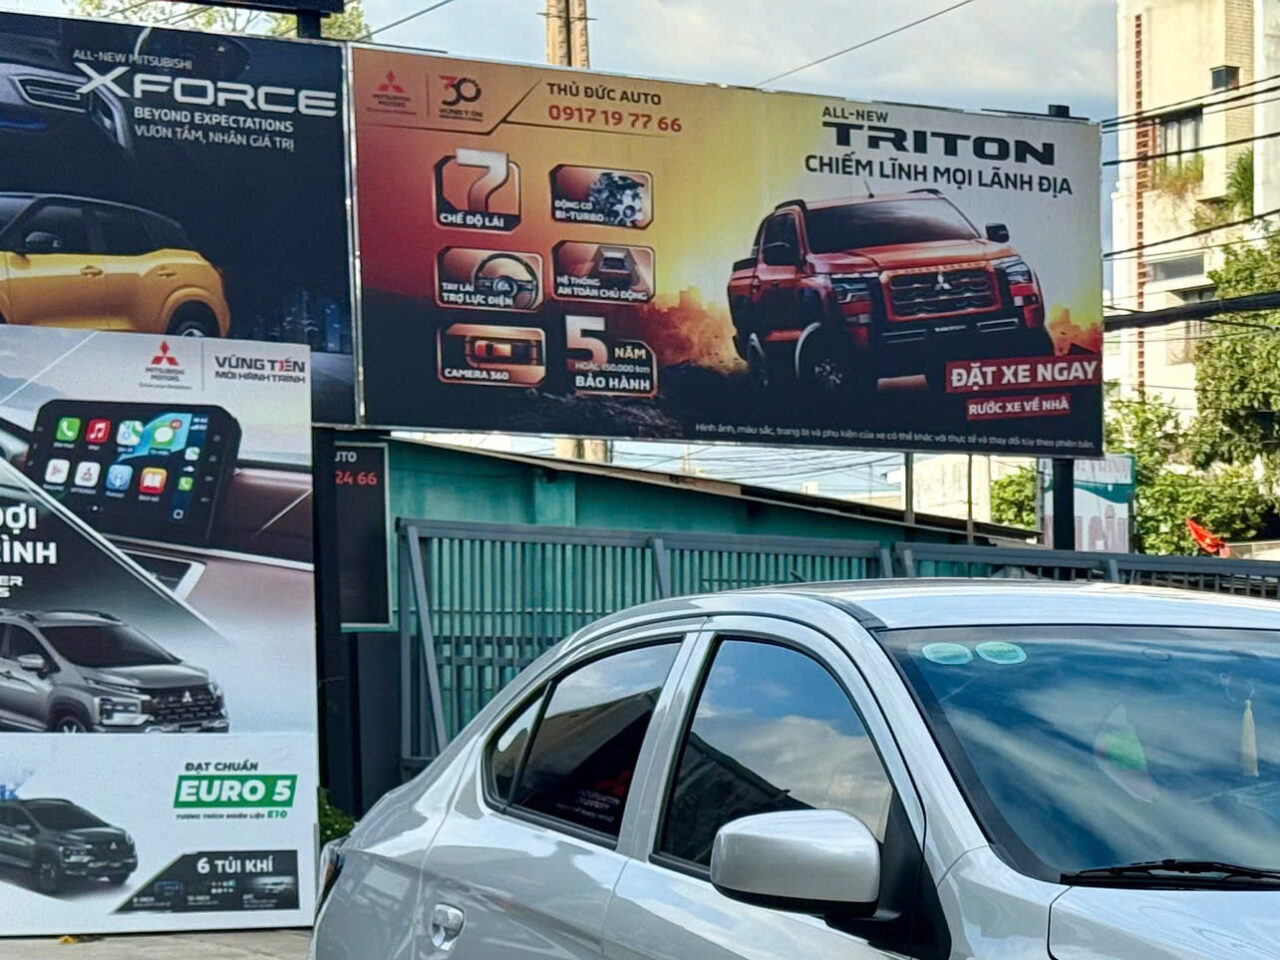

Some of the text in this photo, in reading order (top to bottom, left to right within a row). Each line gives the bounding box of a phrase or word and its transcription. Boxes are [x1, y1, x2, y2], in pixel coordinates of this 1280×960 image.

[72, 49, 193, 70] ALL-NEW MITSUBISHI
[547, 81, 662, 105] THỦ ĐỨC AUTO
[134, 106, 294, 133] BEYOND EXPECTATIONS
[549, 105, 682, 132] 0917 19 77 66
[822, 106, 888, 123] ALL-NEW
[822, 122, 1055, 165] TRITON
[456, 148, 509, 213] 7
[805, 152, 1073, 198] CHIẾM LĨNH MỌI LÃNH ĐỊA
[565, 314, 608, 371] 5
[614, 345, 646, 359] NĂM
[444, 368, 509, 380] CAMERA 360
[951, 361, 1098, 391] ĐẶT XE NGAY
[1005, 402, 1021, 413] XE
[357, 472, 377, 485] 66
[0, 503, 36, 534] ỢI
[0, 534, 57, 564] ÌNH
[178, 779, 292, 802] EURO 5
[196, 857, 210, 874] 6
[245, 855, 274, 873] KHÍ
